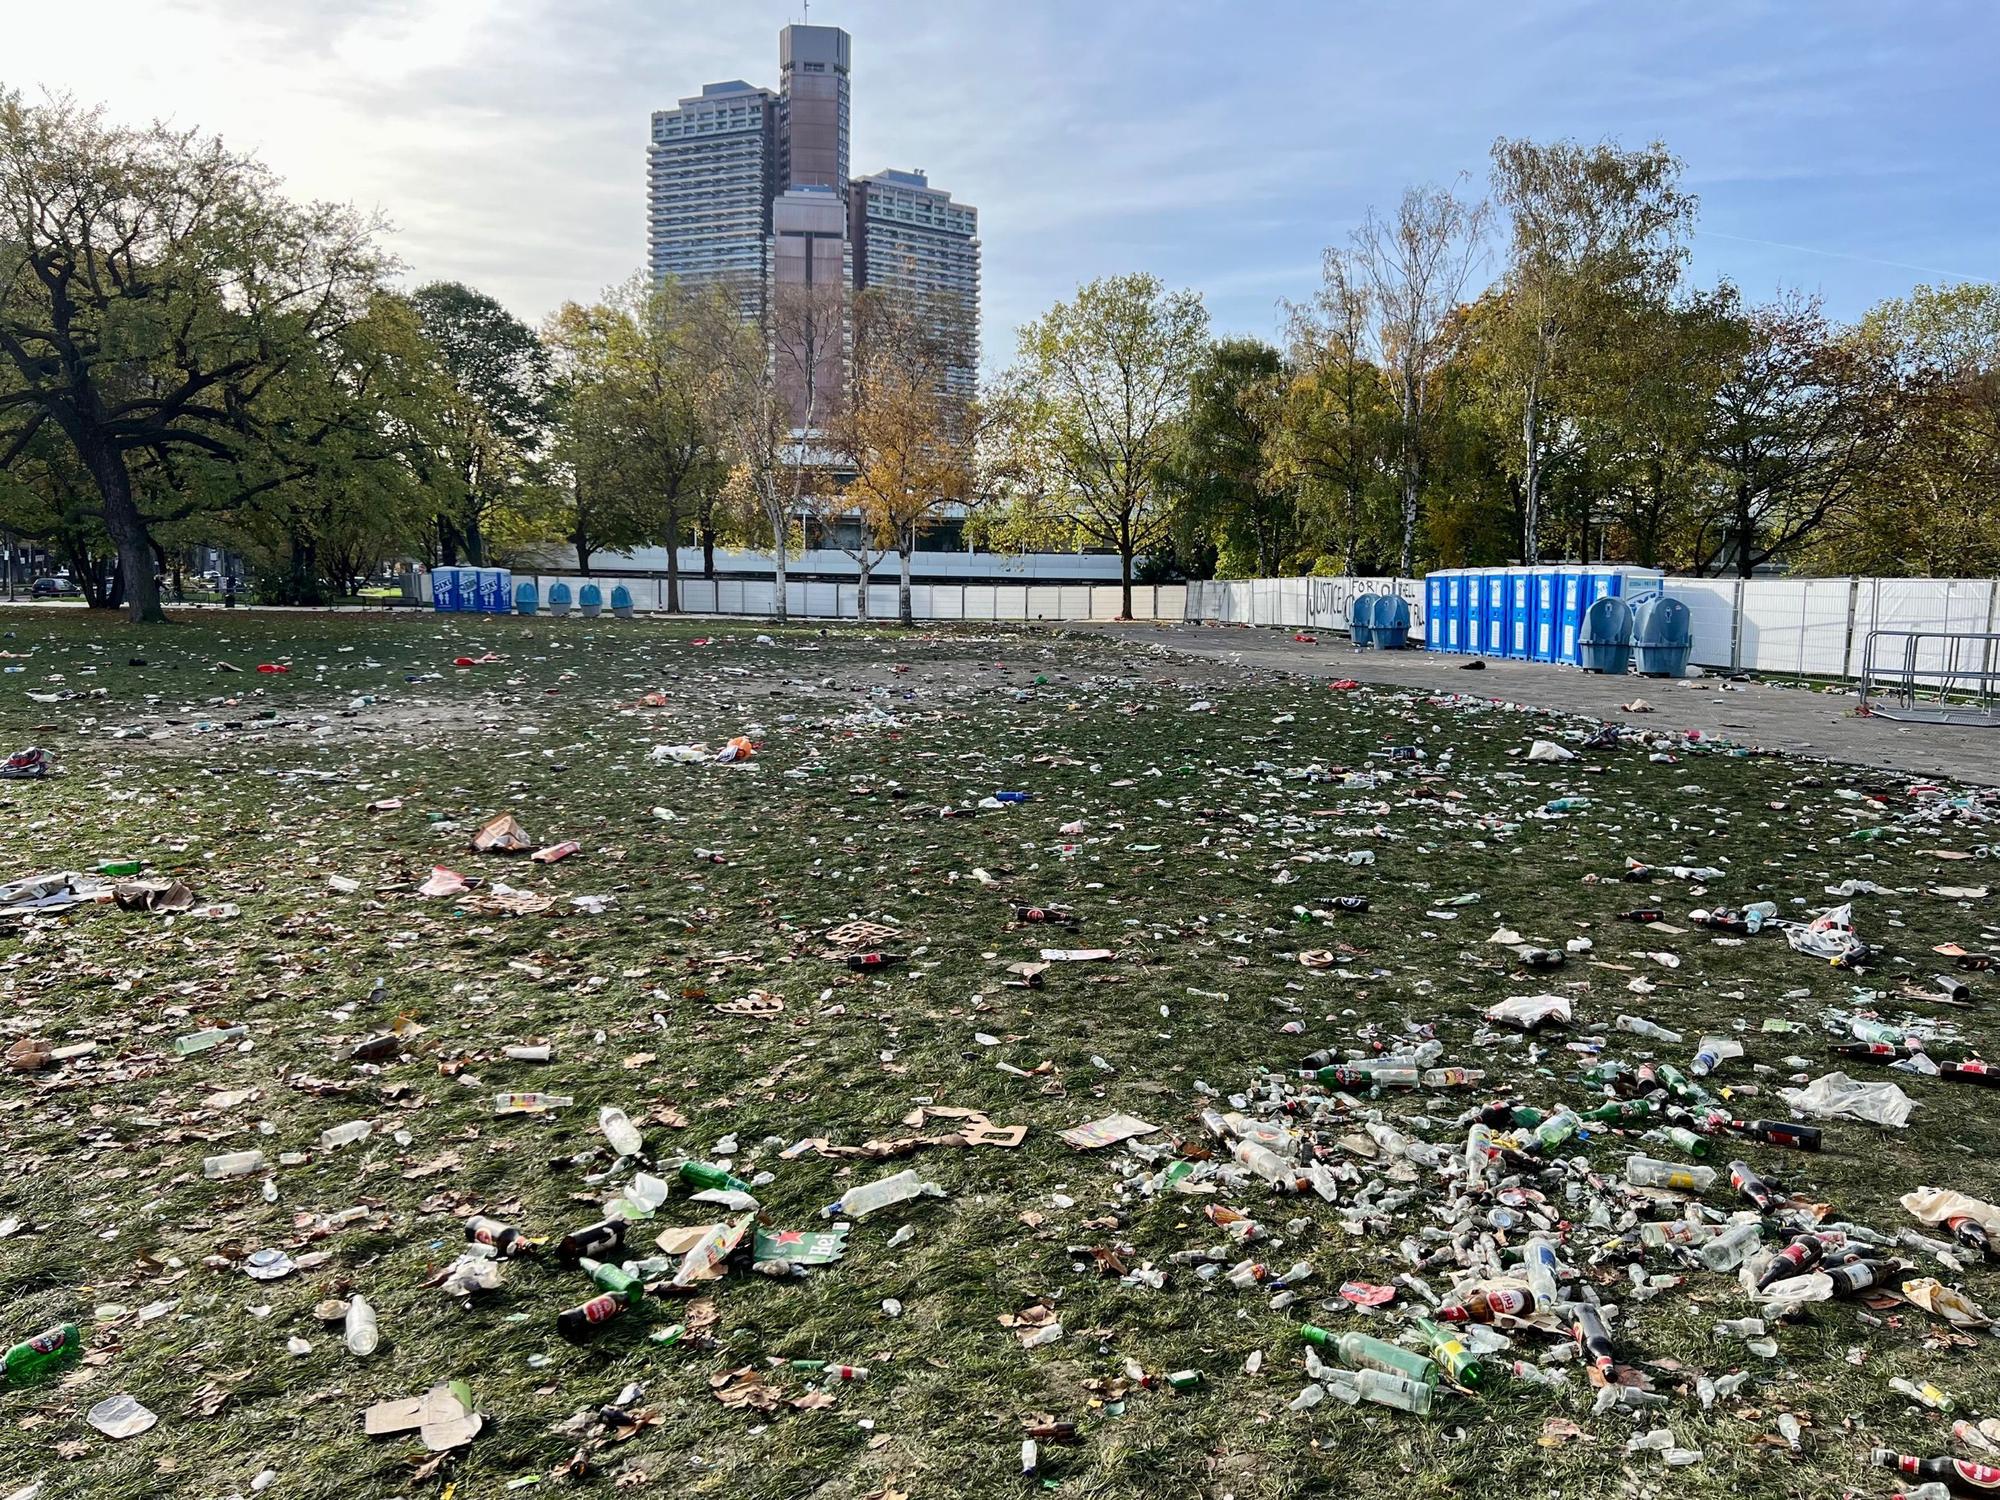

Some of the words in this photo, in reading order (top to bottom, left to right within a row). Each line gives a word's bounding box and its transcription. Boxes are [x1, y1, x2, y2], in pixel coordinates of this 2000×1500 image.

[434, 579, 452, 592] DIXI
[480, 580, 497, 592] DIXI
[1309, 580, 1342, 616] JUSTICE
[1352, 580, 1375, 593] FOR
[808, 1233, 837, 1256] Hei
